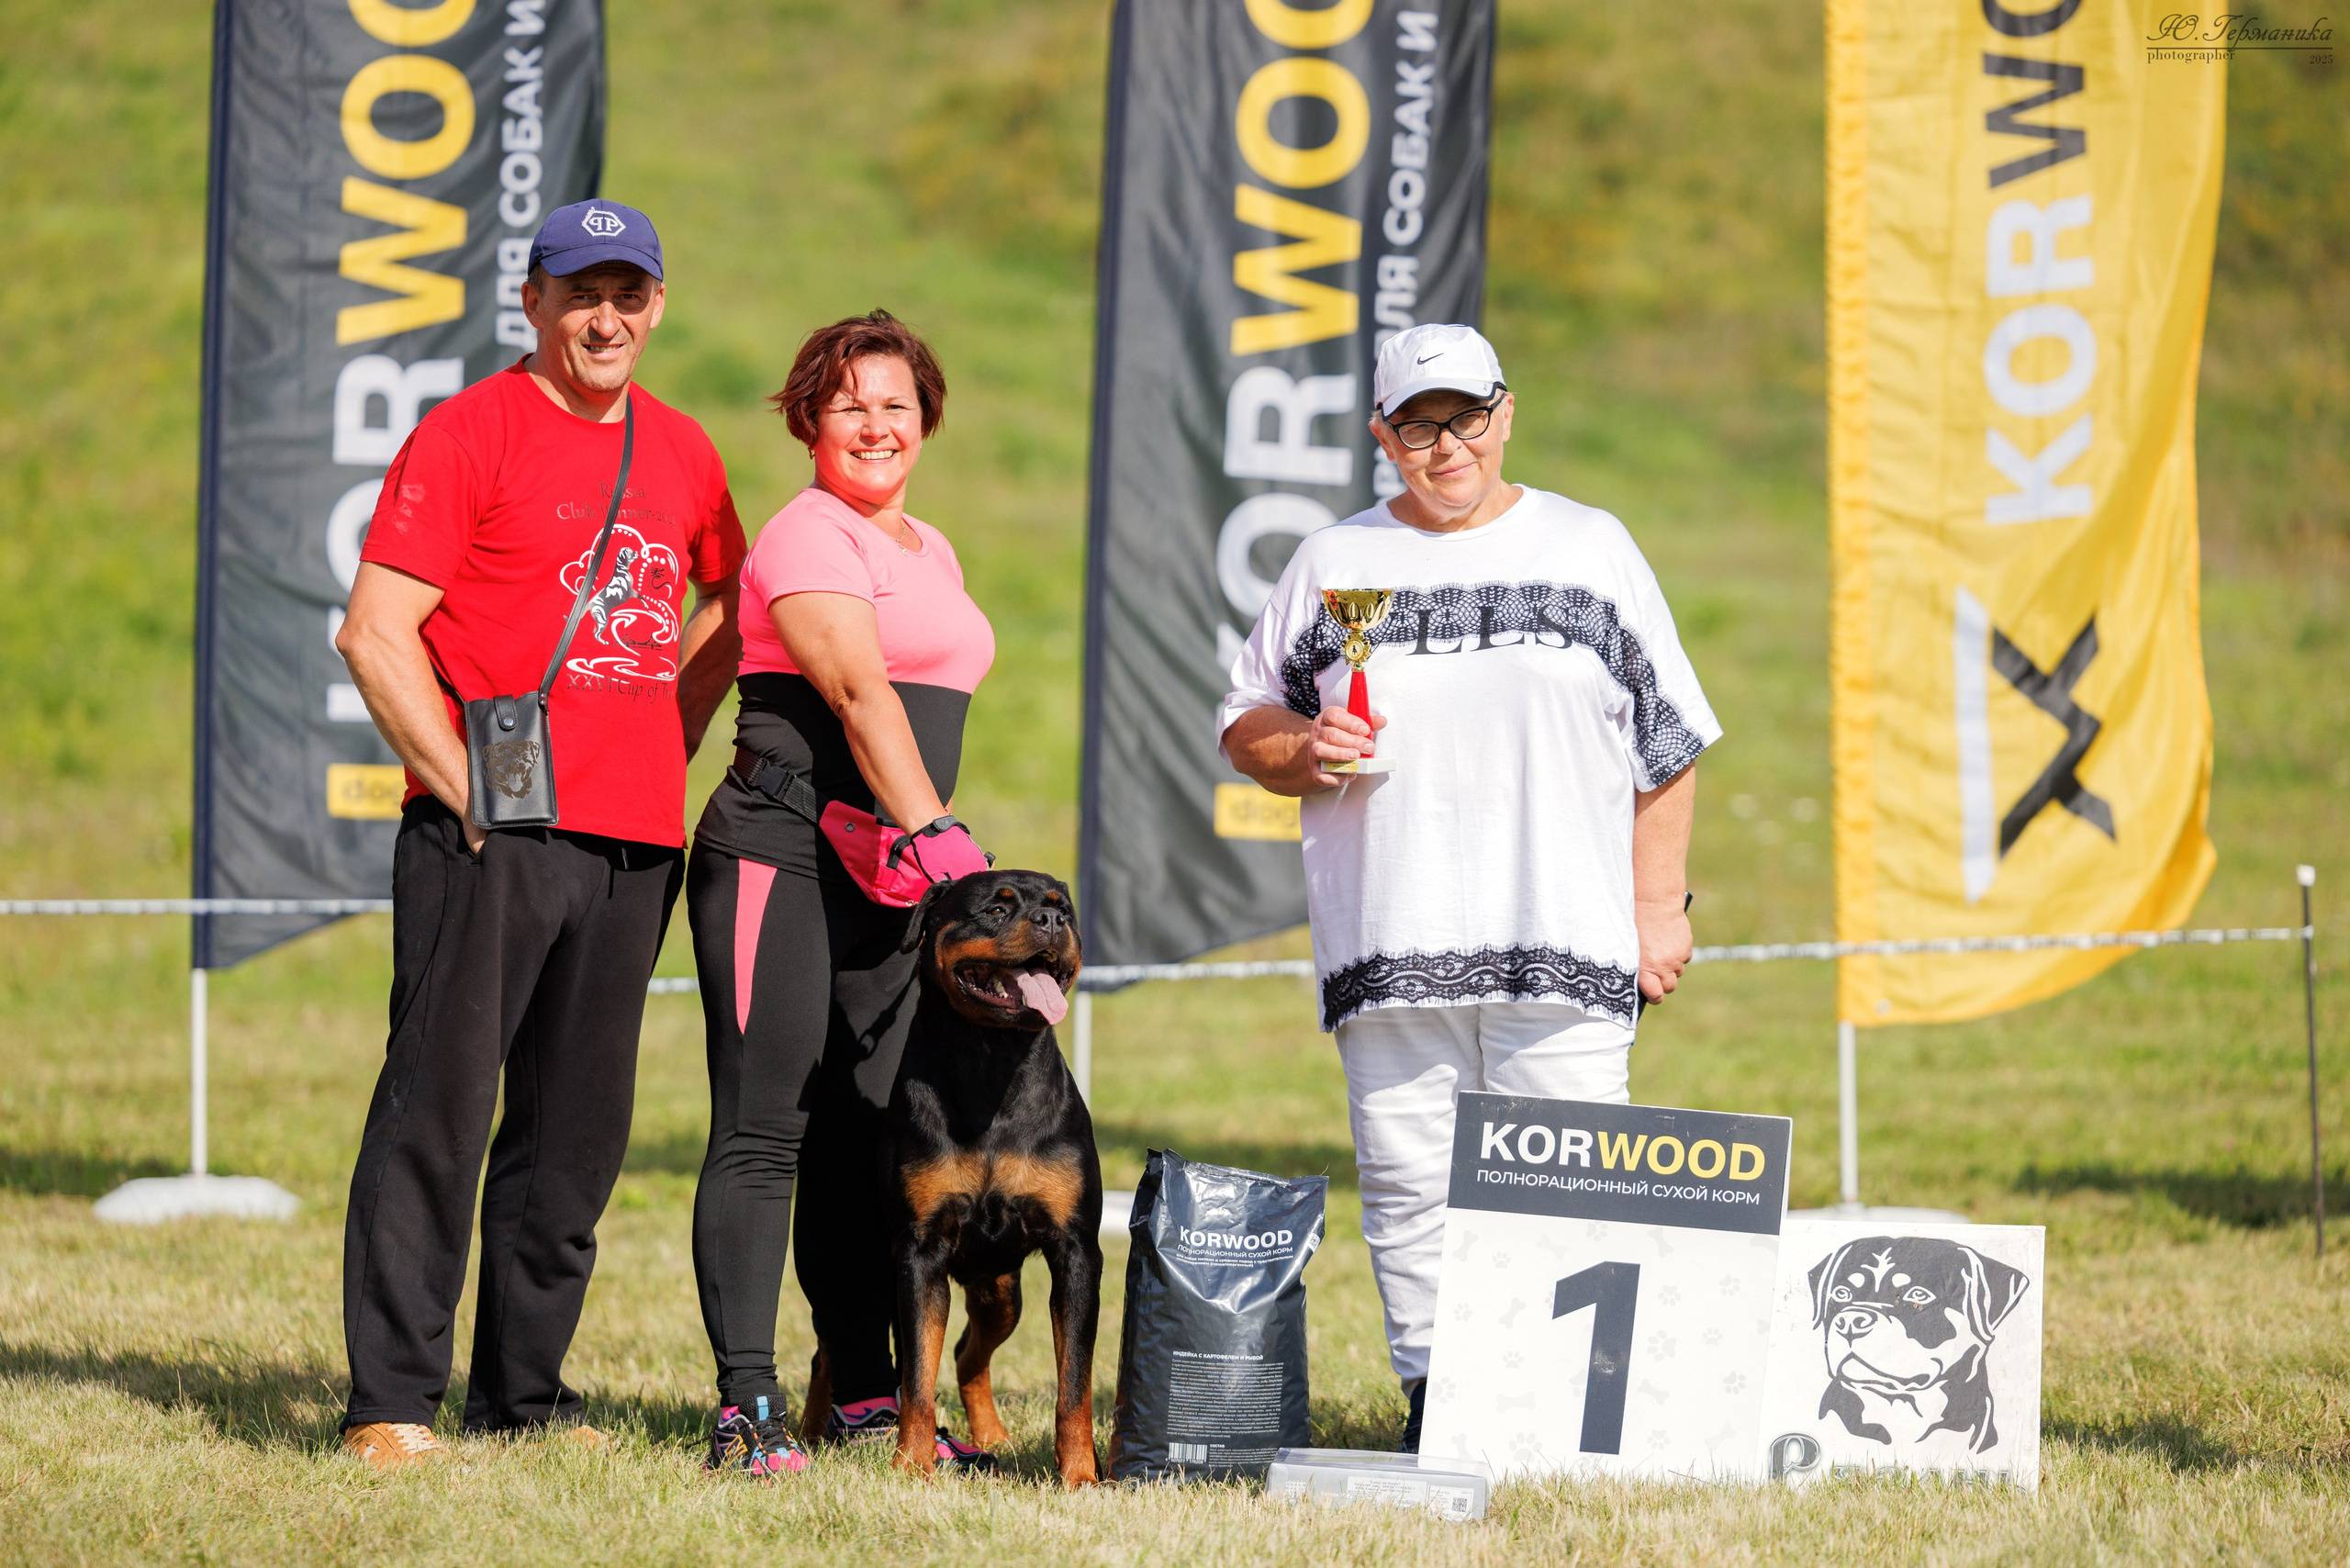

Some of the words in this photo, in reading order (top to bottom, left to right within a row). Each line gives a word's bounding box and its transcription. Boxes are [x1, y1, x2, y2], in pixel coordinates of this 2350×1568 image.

[1395, 11, 1438, 51] И
[498, 46, 543, 228] СОБАК
[1382, 61, 1435, 246] СОБАК
[599, 482, 646, 498] Rsia
[556, 501, 596, 520] Club
[566, 672, 612, 693] XXVI
[617, 677, 643, 702] Cup
[647, 679, 662, 704] of
[1480, 1121, 1765, 1182] KORWOOD
[1476, 1169, 1648, 1195] ПОЛНОРАЦИОННЫЙ
[1651, 1183, 1707, 1202] СУХОЙ
[1712, 1189, 1761, 1205] КОРМ
[1177, 1244, 1248, 1258] ПОЛНОРАЦИОННЫЙ
[1248, 1249, 1271, 1259] СУХОЙ
[1272, 1247, 1293, 1256] КОРМ
[1180, 1225, 1293, 1249] KORWOOD
[1552, 1261, 1641, 1455] 1
